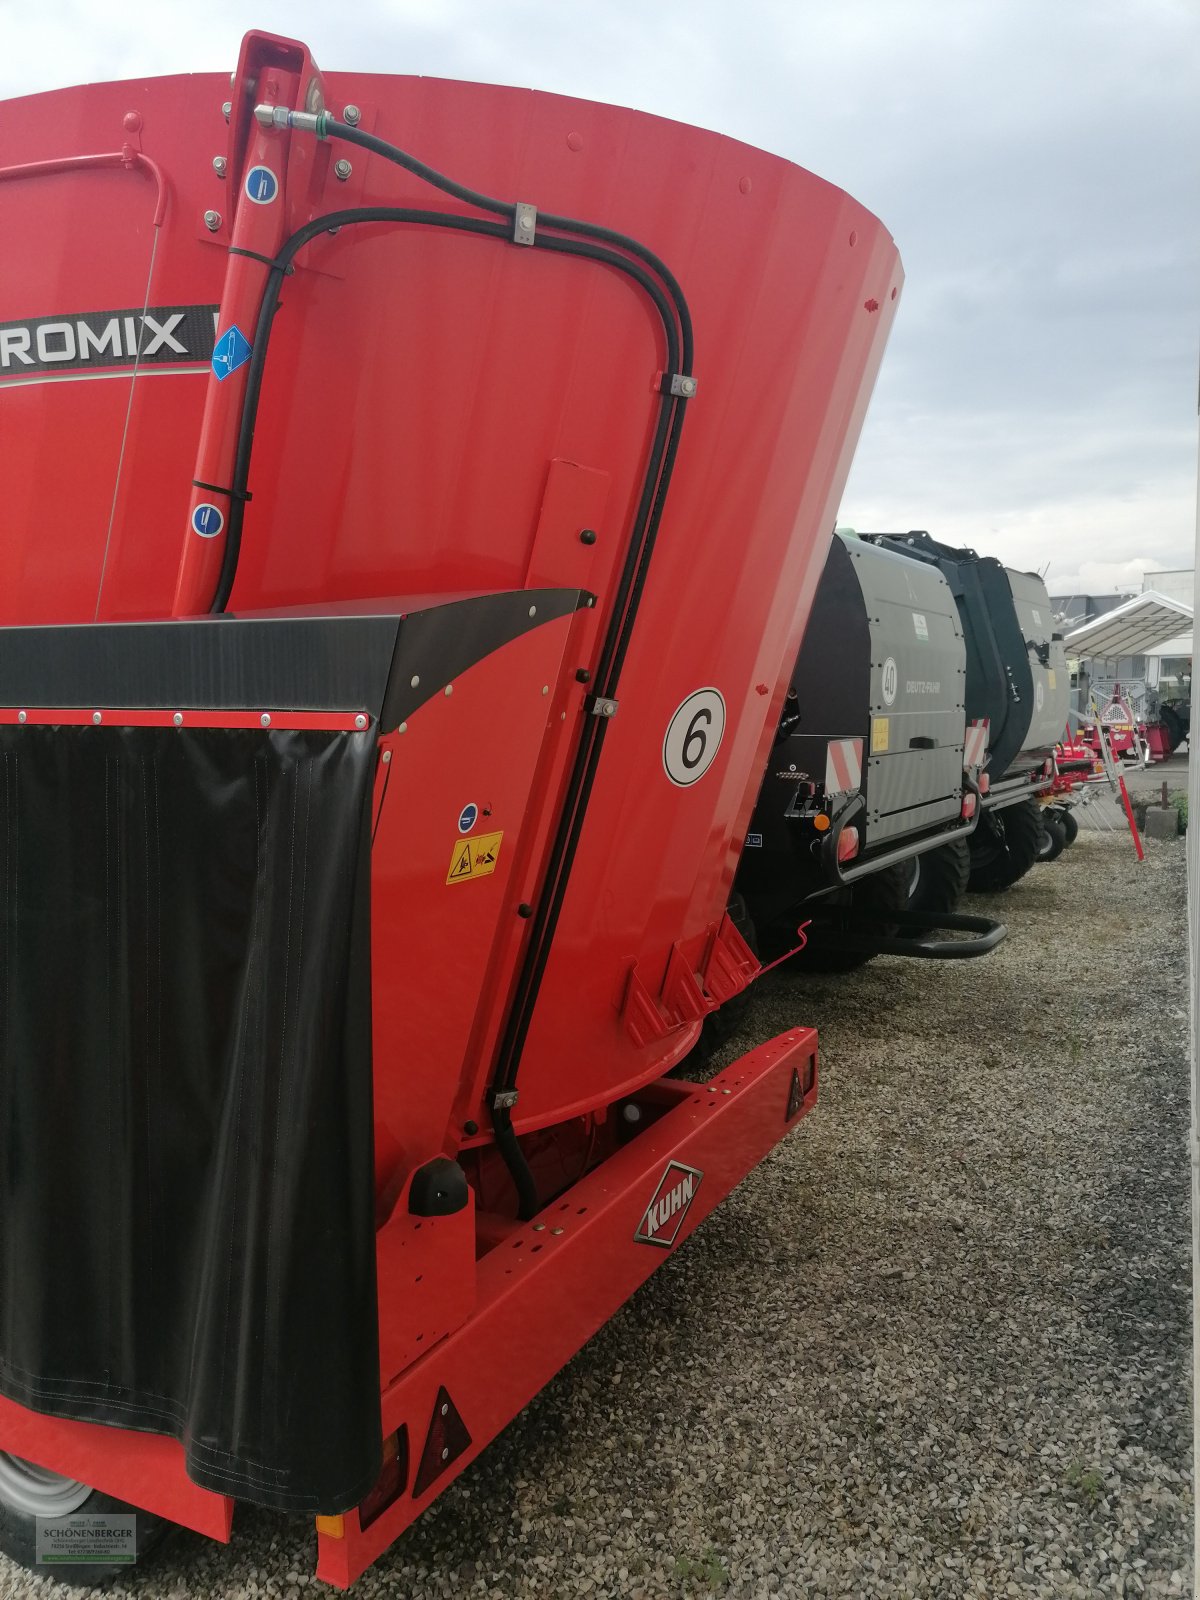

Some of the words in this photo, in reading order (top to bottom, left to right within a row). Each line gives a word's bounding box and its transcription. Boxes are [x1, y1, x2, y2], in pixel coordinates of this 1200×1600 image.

[0, 313, 189, 367] ROMIX
[885, 665, 895, 695] 40
[906, 680, 941, 695] DEUTZ-FAHR
[681, 708, 712, 769] 6
[648, 1172, 694, 1238] KUHN
